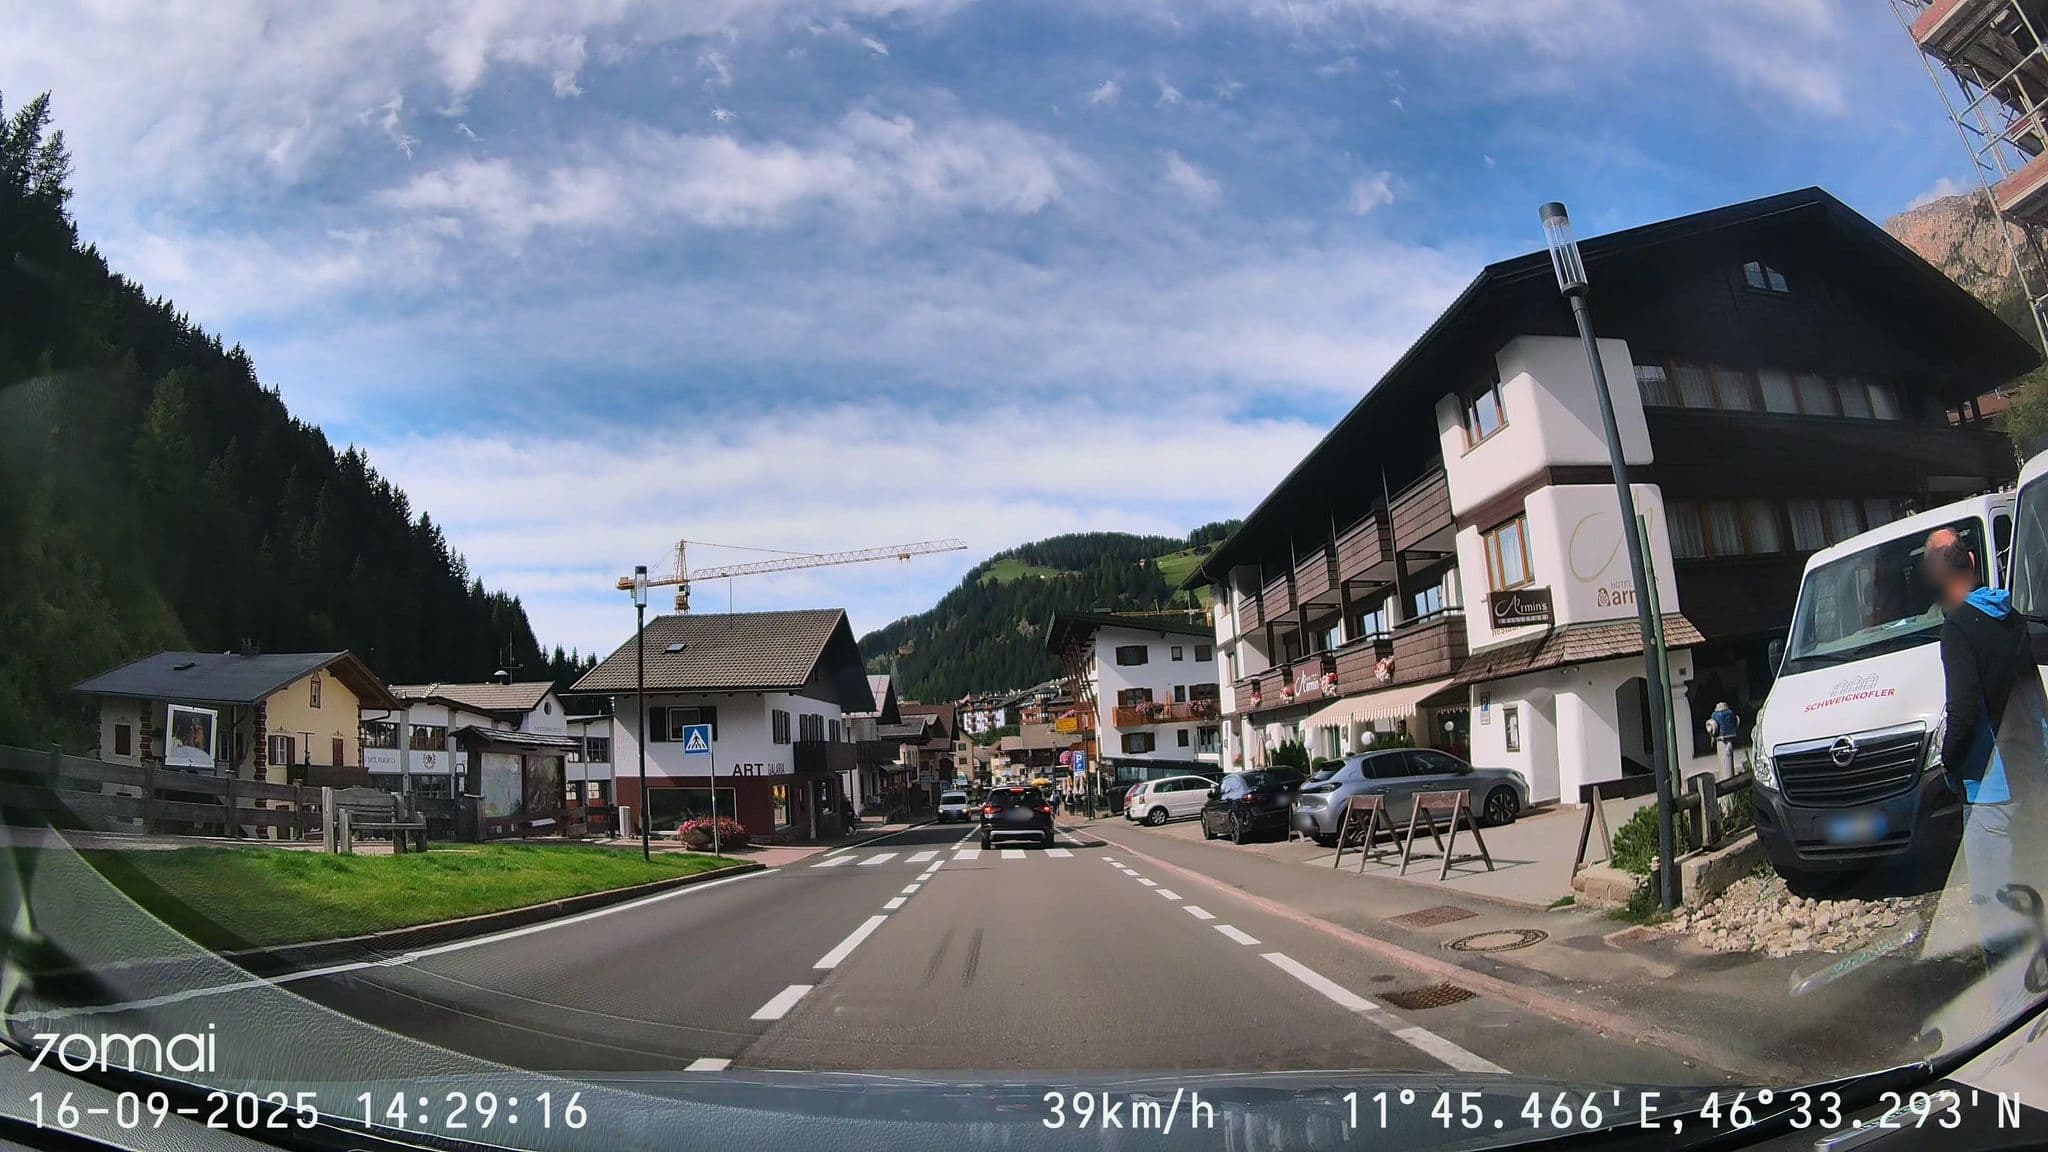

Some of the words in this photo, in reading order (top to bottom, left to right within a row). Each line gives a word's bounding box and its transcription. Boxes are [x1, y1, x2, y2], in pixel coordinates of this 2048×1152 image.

[1495, 594, 1549, 616] Armin's
[1803, 688, 1896, 713] SCHWEIGKOFLER
[1076, 754, 1082, 763] P
[732, 763, 764, 777] ART
